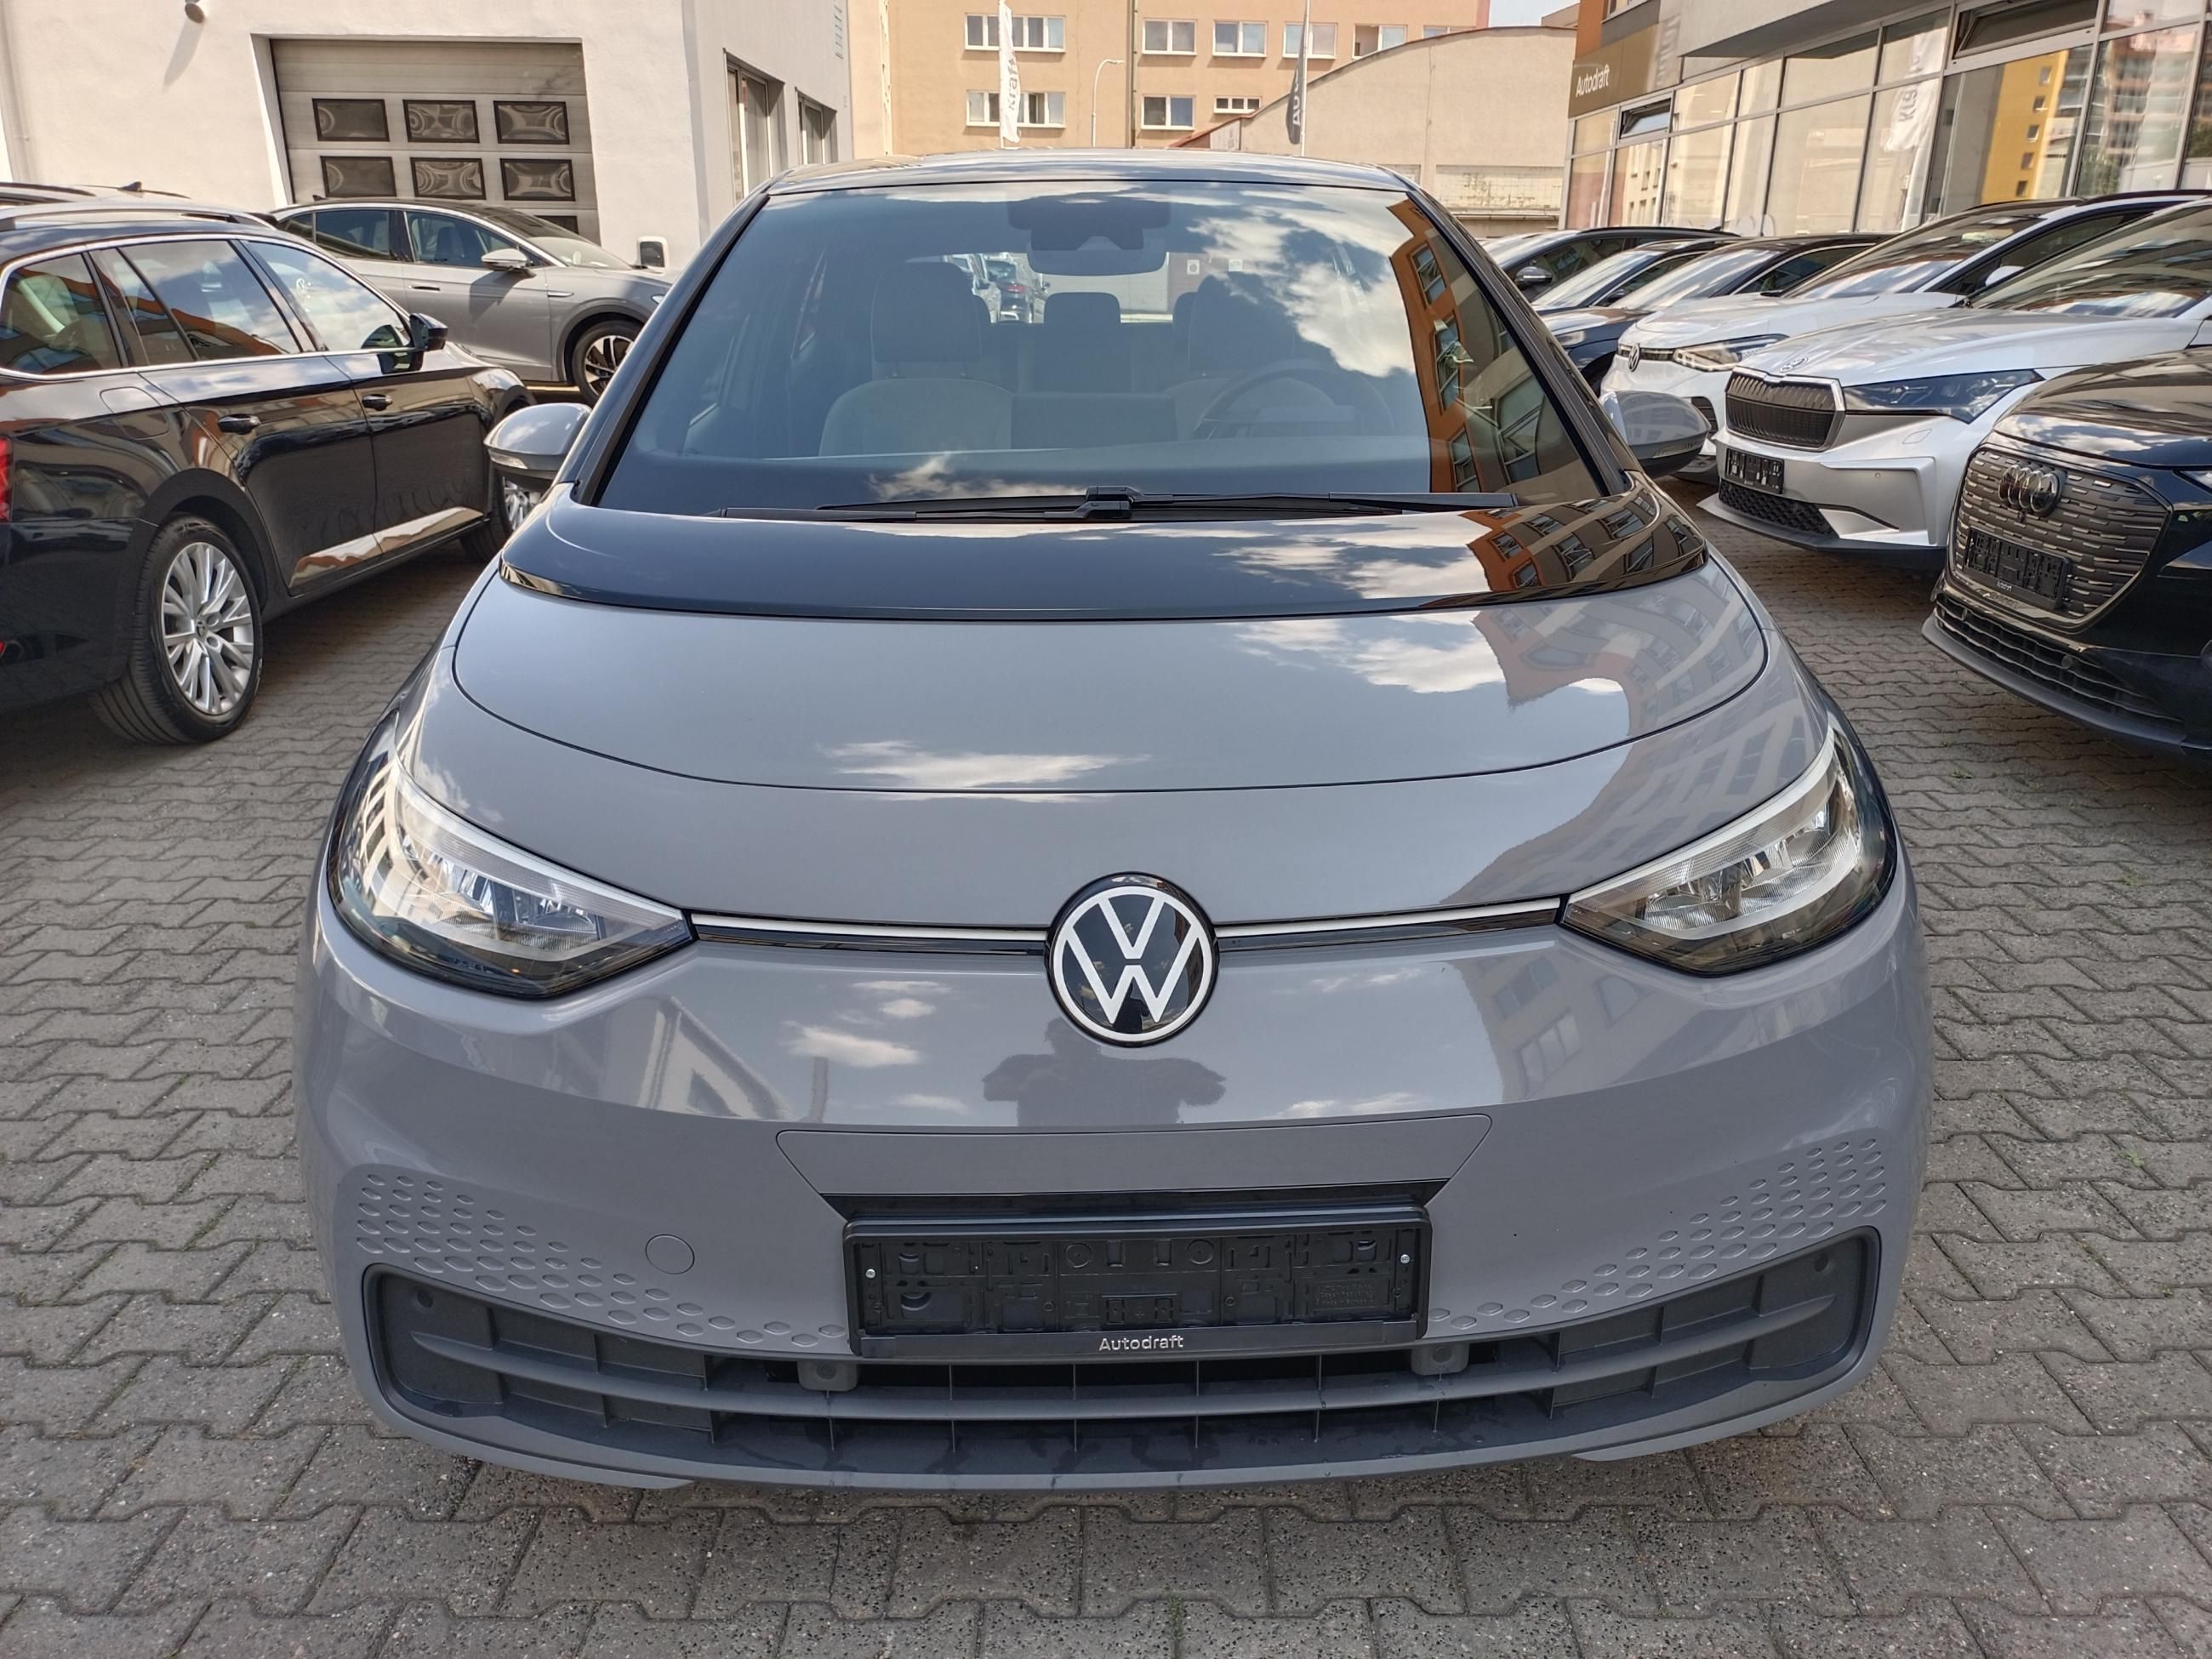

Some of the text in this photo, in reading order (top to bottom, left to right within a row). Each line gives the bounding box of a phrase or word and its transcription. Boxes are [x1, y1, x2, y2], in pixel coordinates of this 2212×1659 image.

[1576, 64, 1610, 98] Autodraft
[1053, 887, 1211, 1042] VW
[1098, 1335, 1184, 1351] Autodraft
